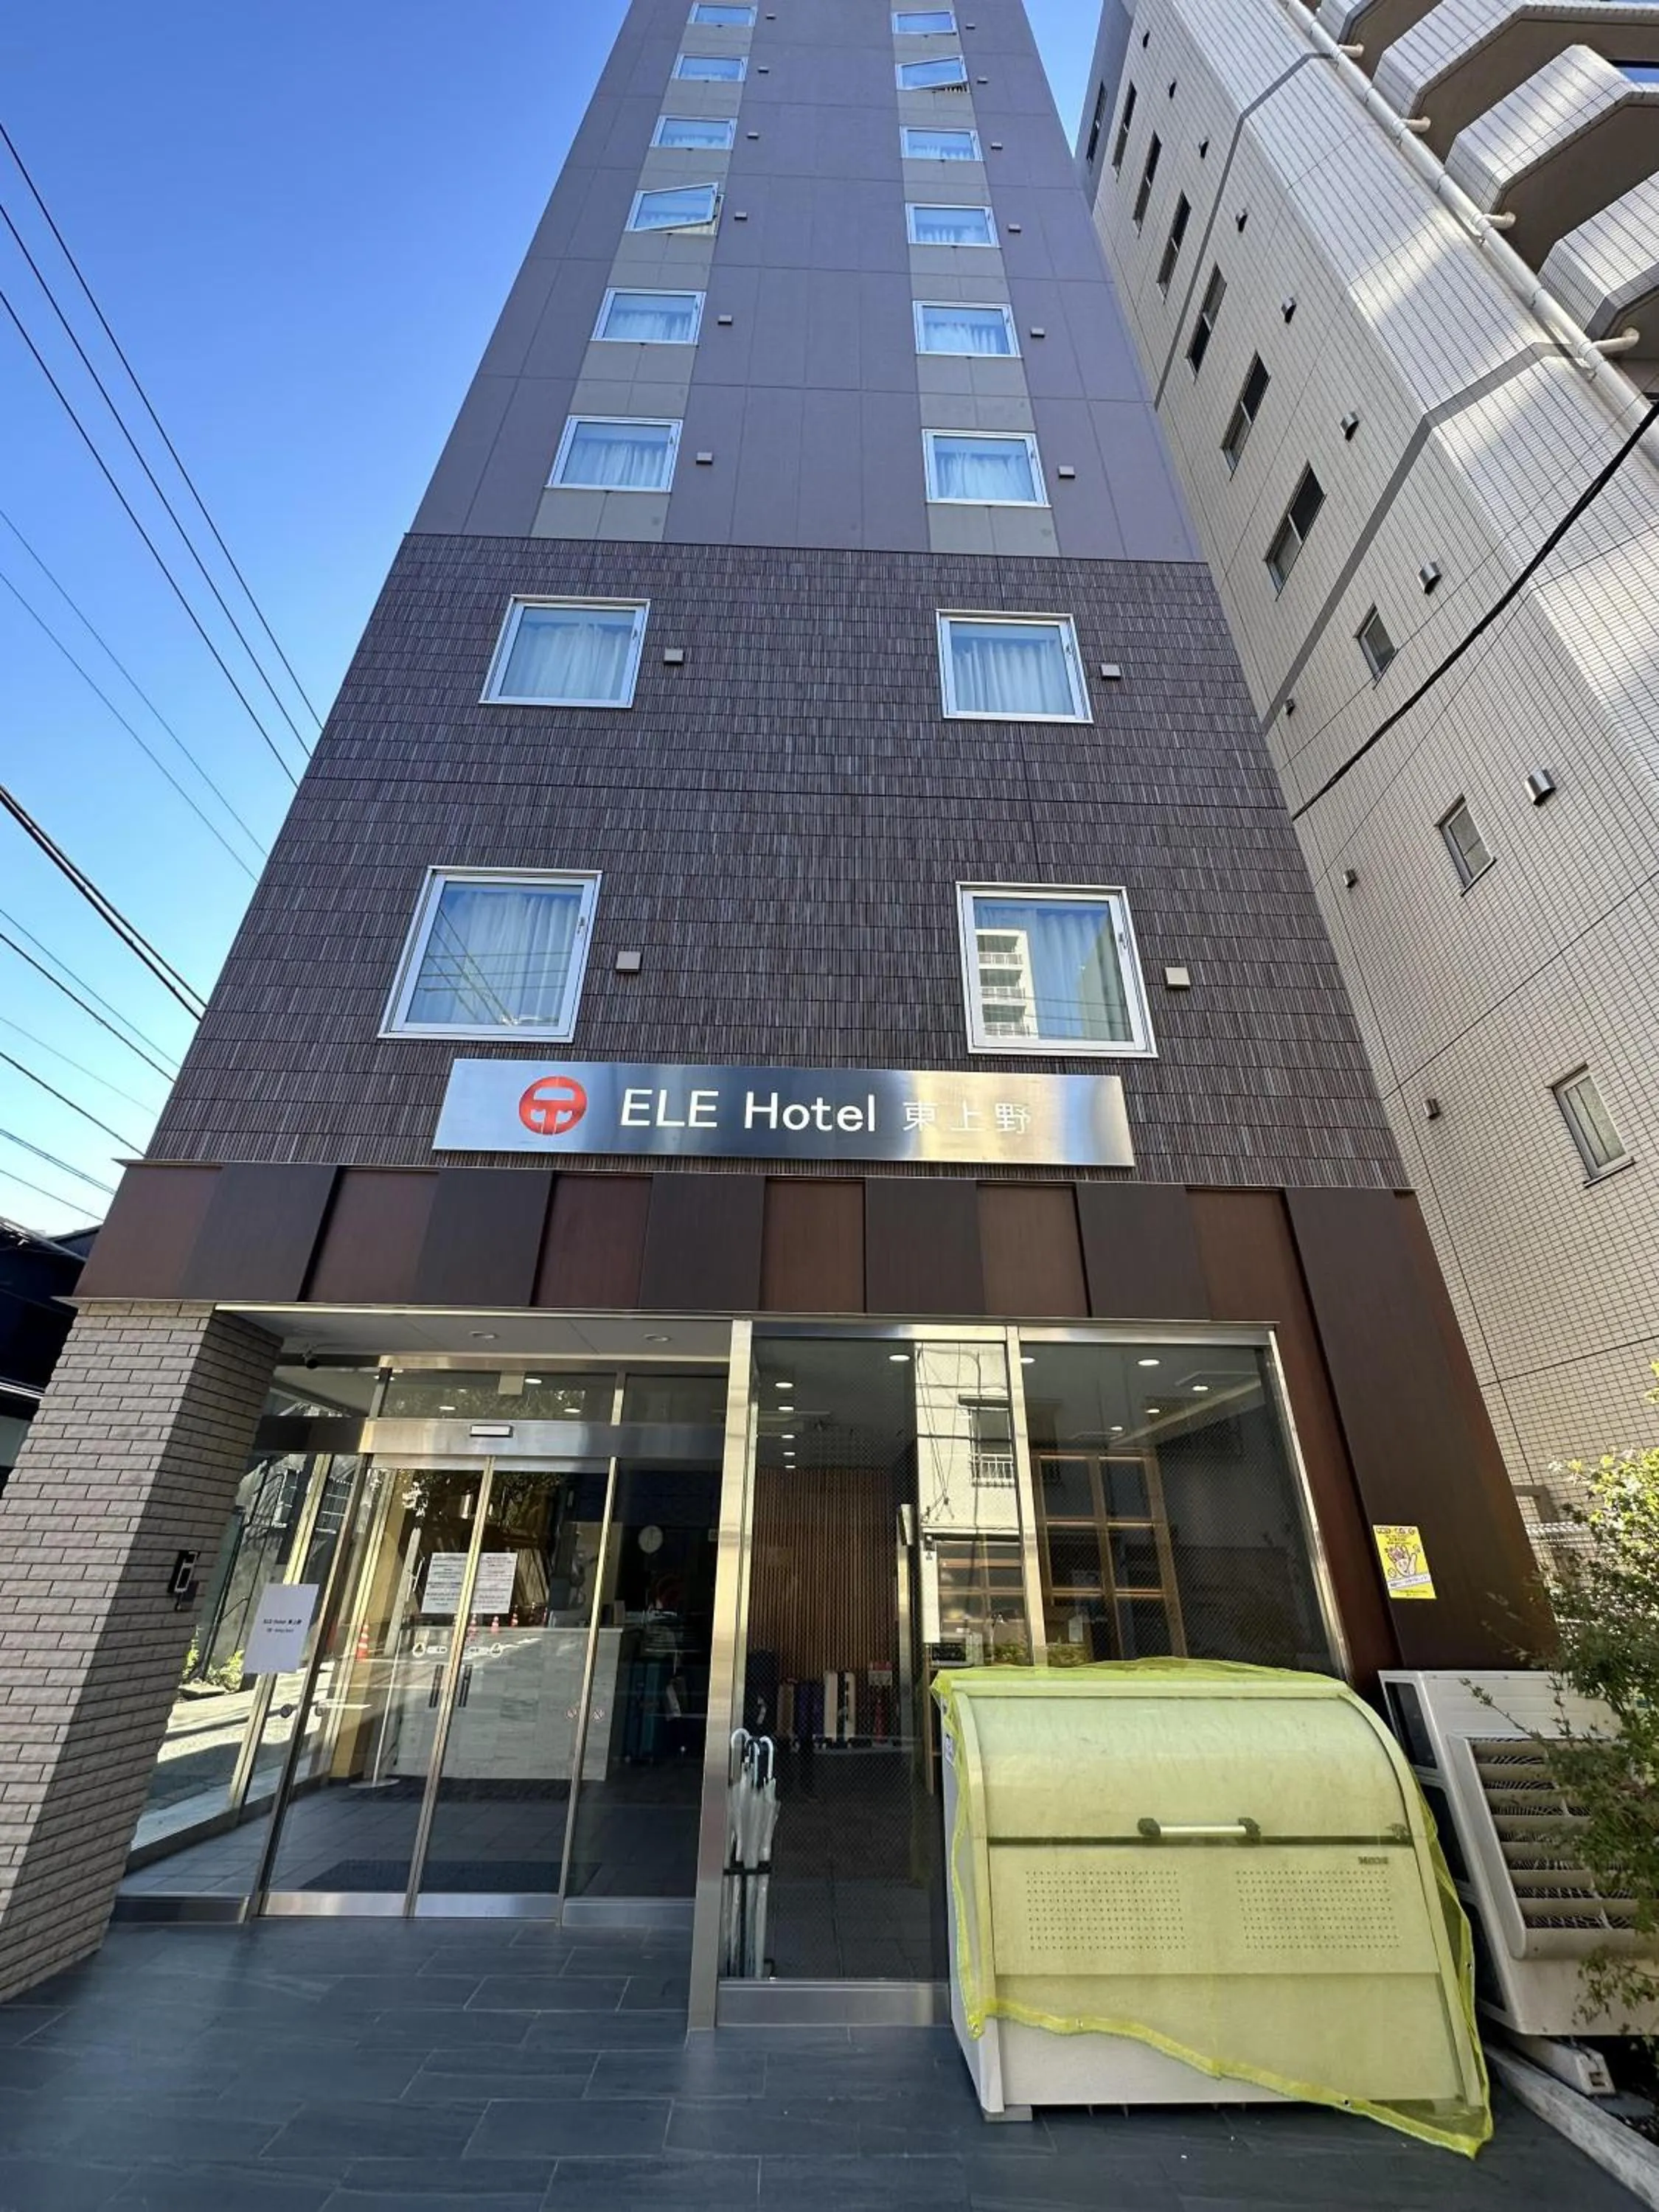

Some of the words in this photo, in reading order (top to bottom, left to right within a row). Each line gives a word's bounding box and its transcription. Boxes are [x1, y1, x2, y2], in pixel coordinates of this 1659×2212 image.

[620, 1088, 719, 1127] ELE
[744, 1091, 875, 1132] Hotel
[902, 1100, 1032, 1134] 東上野
